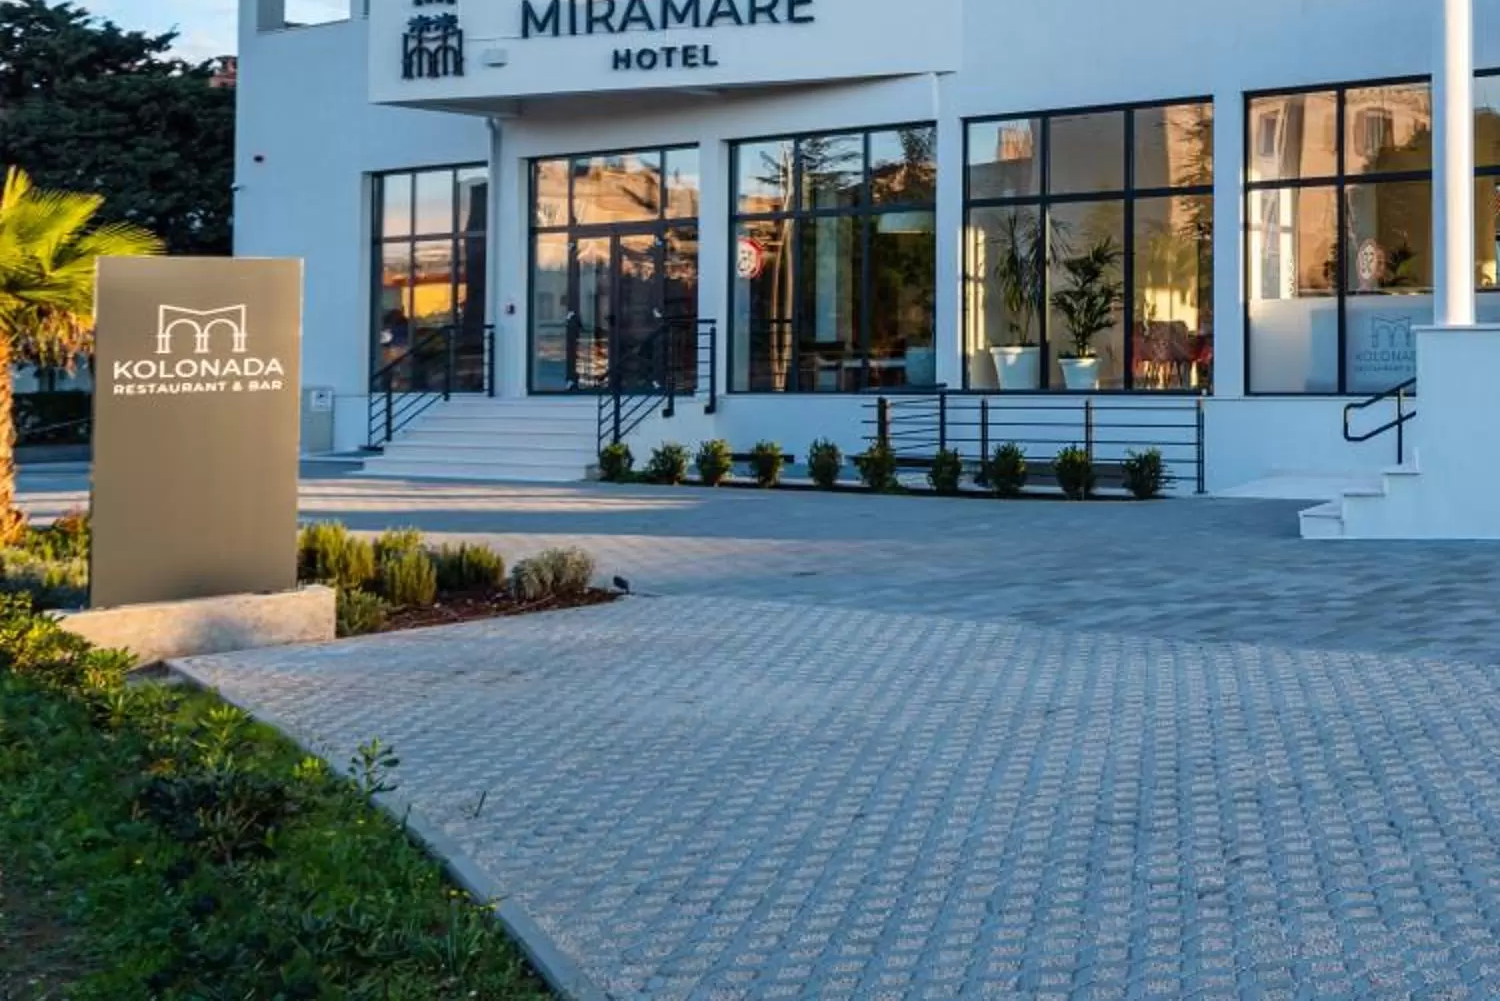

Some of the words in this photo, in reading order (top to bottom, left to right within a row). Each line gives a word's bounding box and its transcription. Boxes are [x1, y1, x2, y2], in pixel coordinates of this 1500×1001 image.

[612, 44, 719, 70] HOTEL
[113, 358, 284, 380] KOLONADA
[113, 381, 226, 395] RESTAURANT
[232, 381, 243, 392] &
[249, 380, 283, 392] BAR
